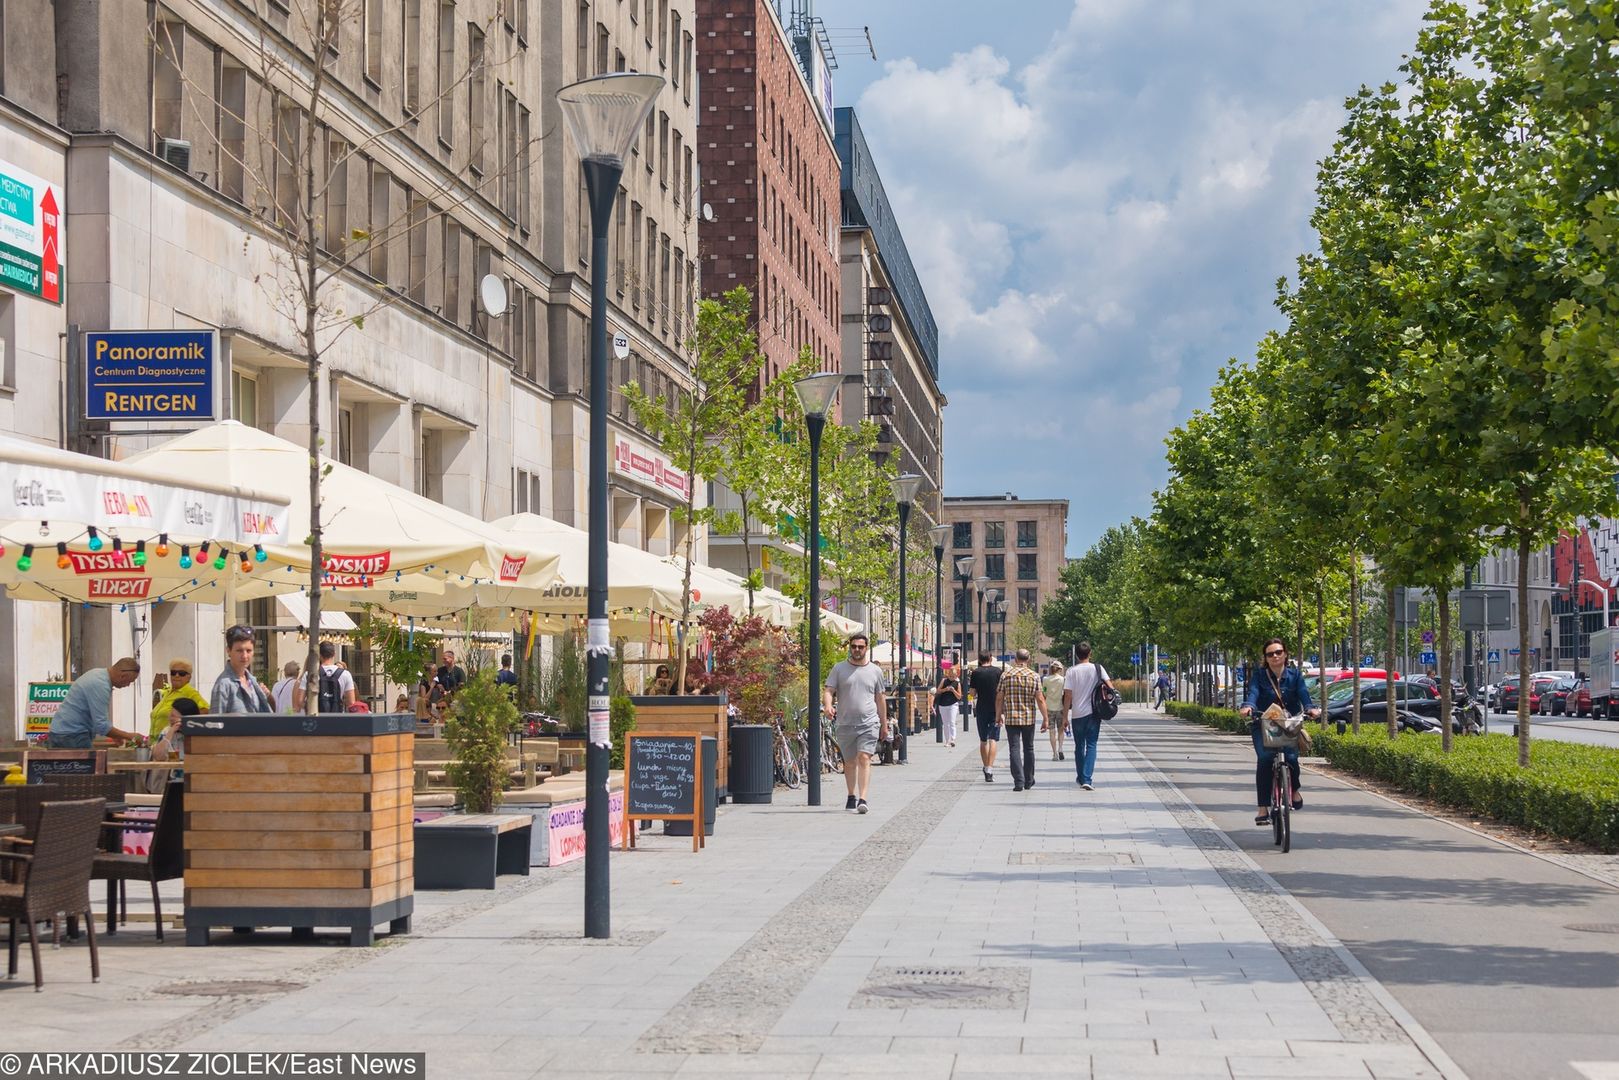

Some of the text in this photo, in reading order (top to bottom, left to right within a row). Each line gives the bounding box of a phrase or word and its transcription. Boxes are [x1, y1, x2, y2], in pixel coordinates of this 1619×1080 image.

[95, 340, 205, 360] Panoramik
[95, 366, 206, 377] Centrum Diagnostyczne
[105, 391, 196, 411] RENTGEN
[29, 703, 60, 714] EXCHA
